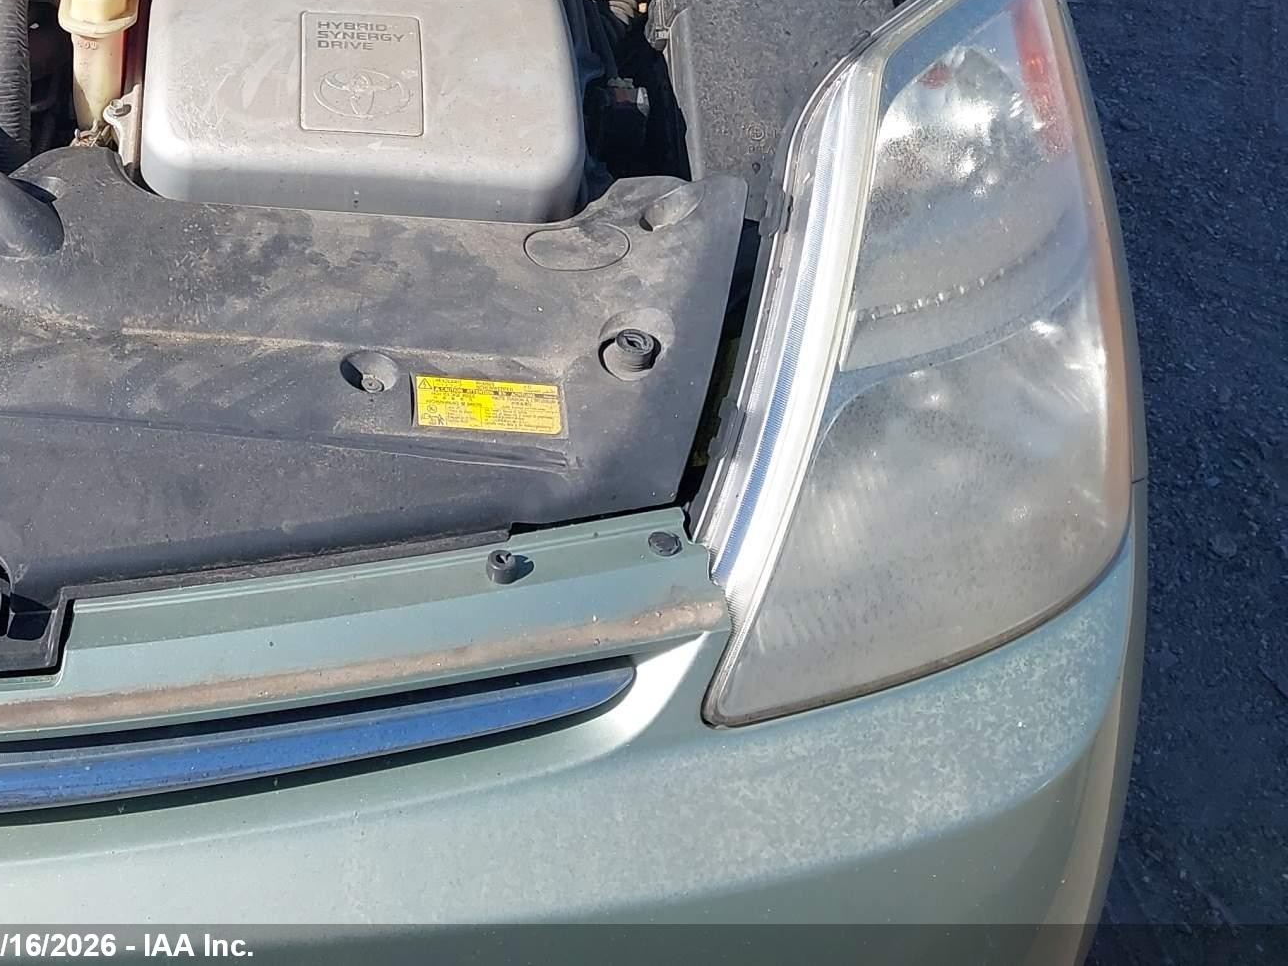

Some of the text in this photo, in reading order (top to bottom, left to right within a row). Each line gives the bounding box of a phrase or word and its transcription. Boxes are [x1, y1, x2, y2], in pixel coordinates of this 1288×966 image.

[318, 21, 388, 32] HYBRID
[317, 30, 405, 42] SYNERGY
[318, 40, 374, 51] DRIVE
